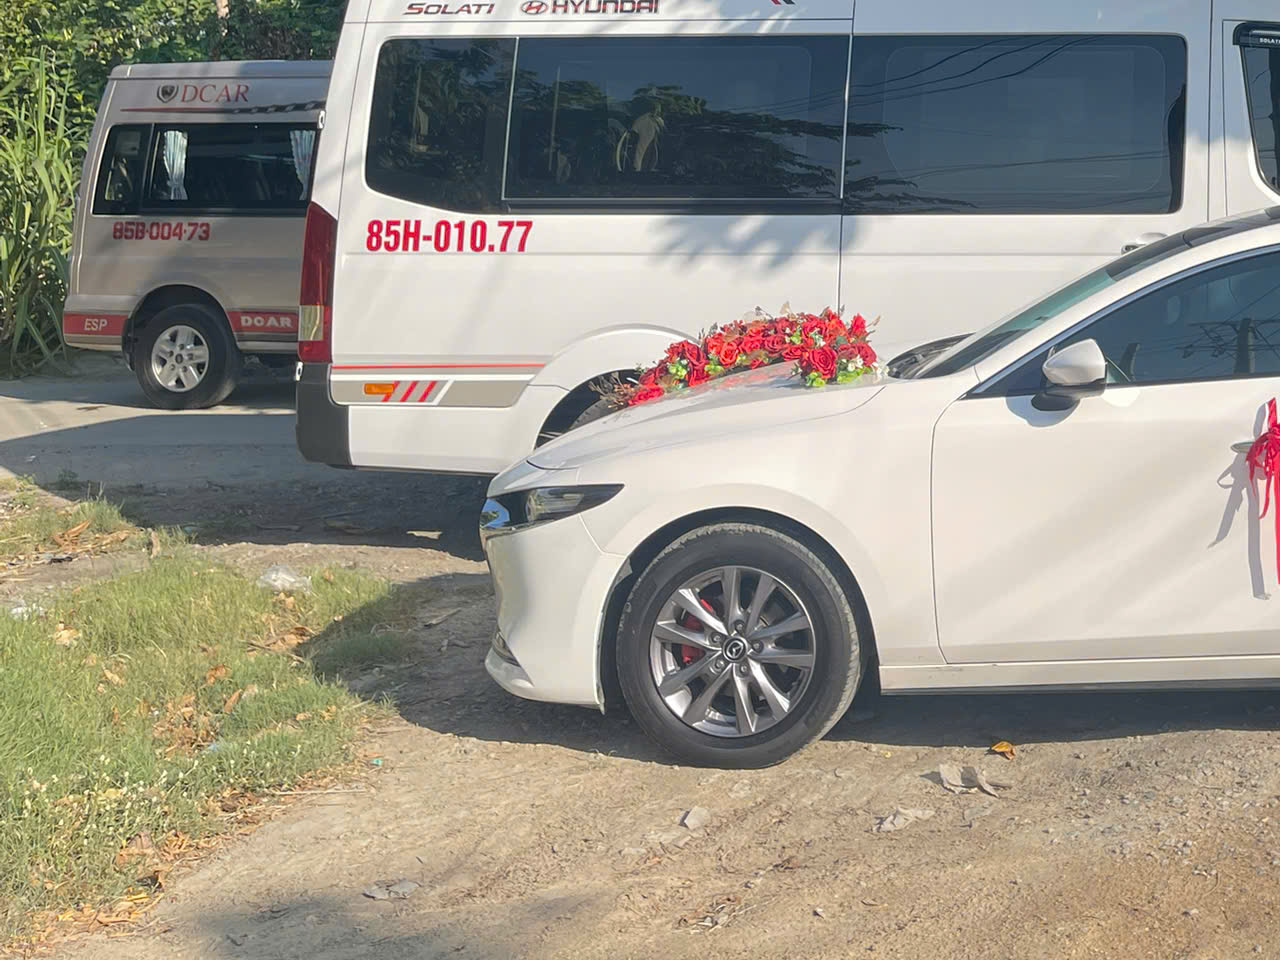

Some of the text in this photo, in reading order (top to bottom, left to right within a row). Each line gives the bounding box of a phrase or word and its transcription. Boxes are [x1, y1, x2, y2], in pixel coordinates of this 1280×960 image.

[402, 2, 496, 16] SOLATI
[552, 0, 660, 14] HYUNDAI
[181, 83, 249, 103] DCAR
[366, 220, 533, 252] 85H-010.77
[83, 318, 108, 331] ESP
[240, 315, 293, 328] DCAR
